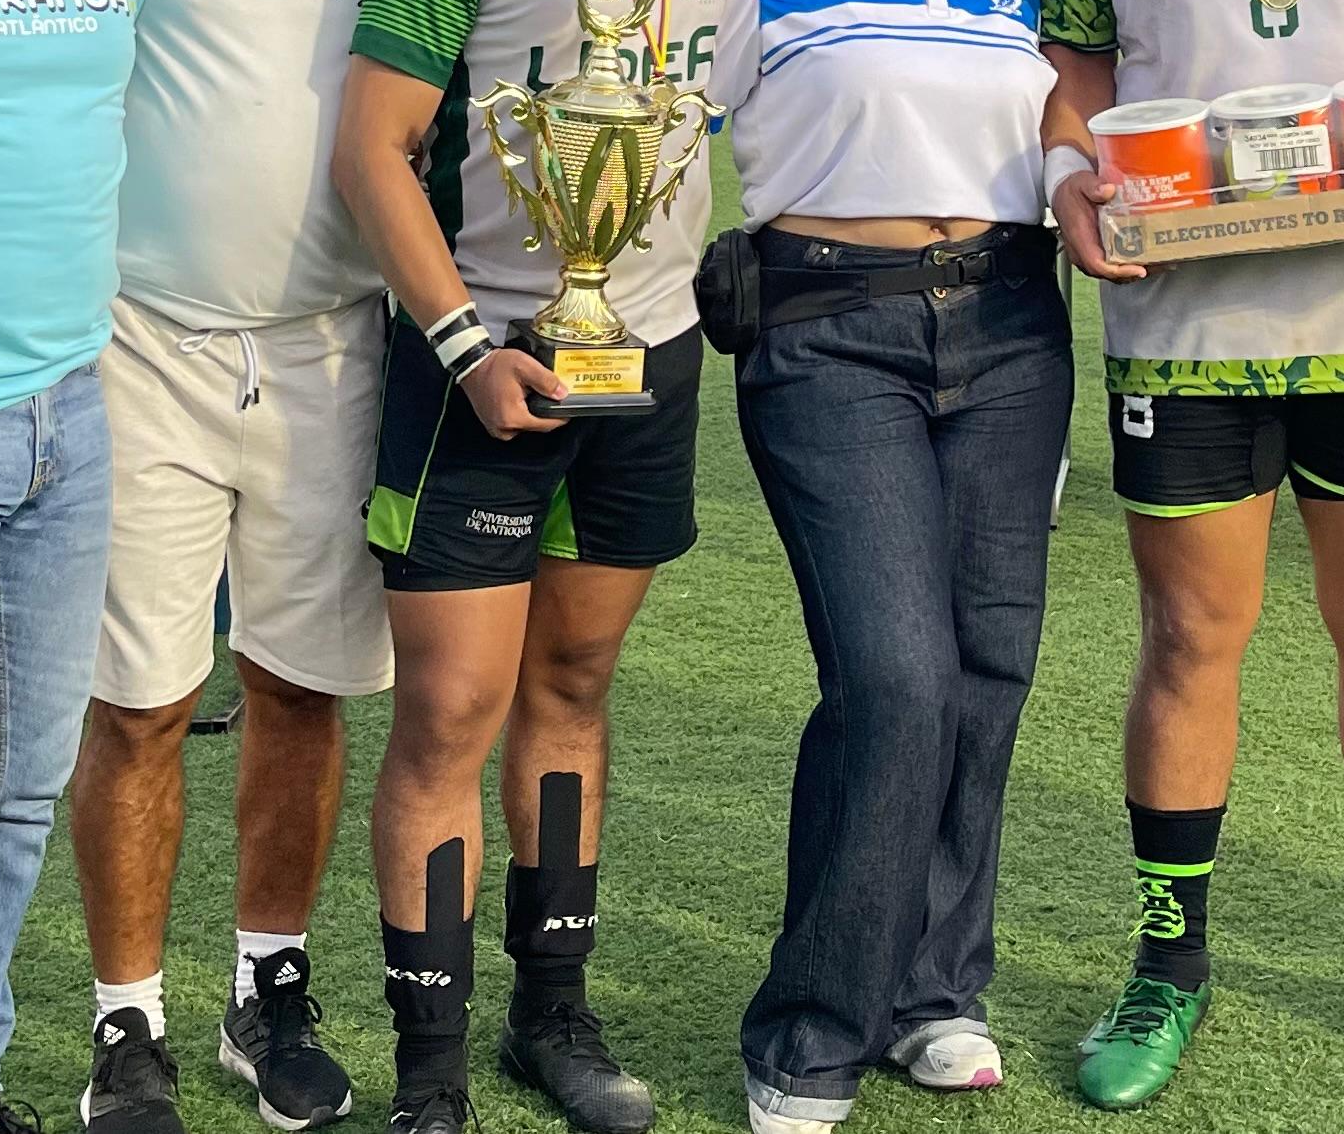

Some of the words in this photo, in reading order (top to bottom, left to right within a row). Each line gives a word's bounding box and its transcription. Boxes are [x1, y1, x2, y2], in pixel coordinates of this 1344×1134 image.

[1154, 214, 1299, 245] ELECTROLYTES
[1303, 211, 1330, 227] TO
[583, 373, 621, 381] PUESTO
